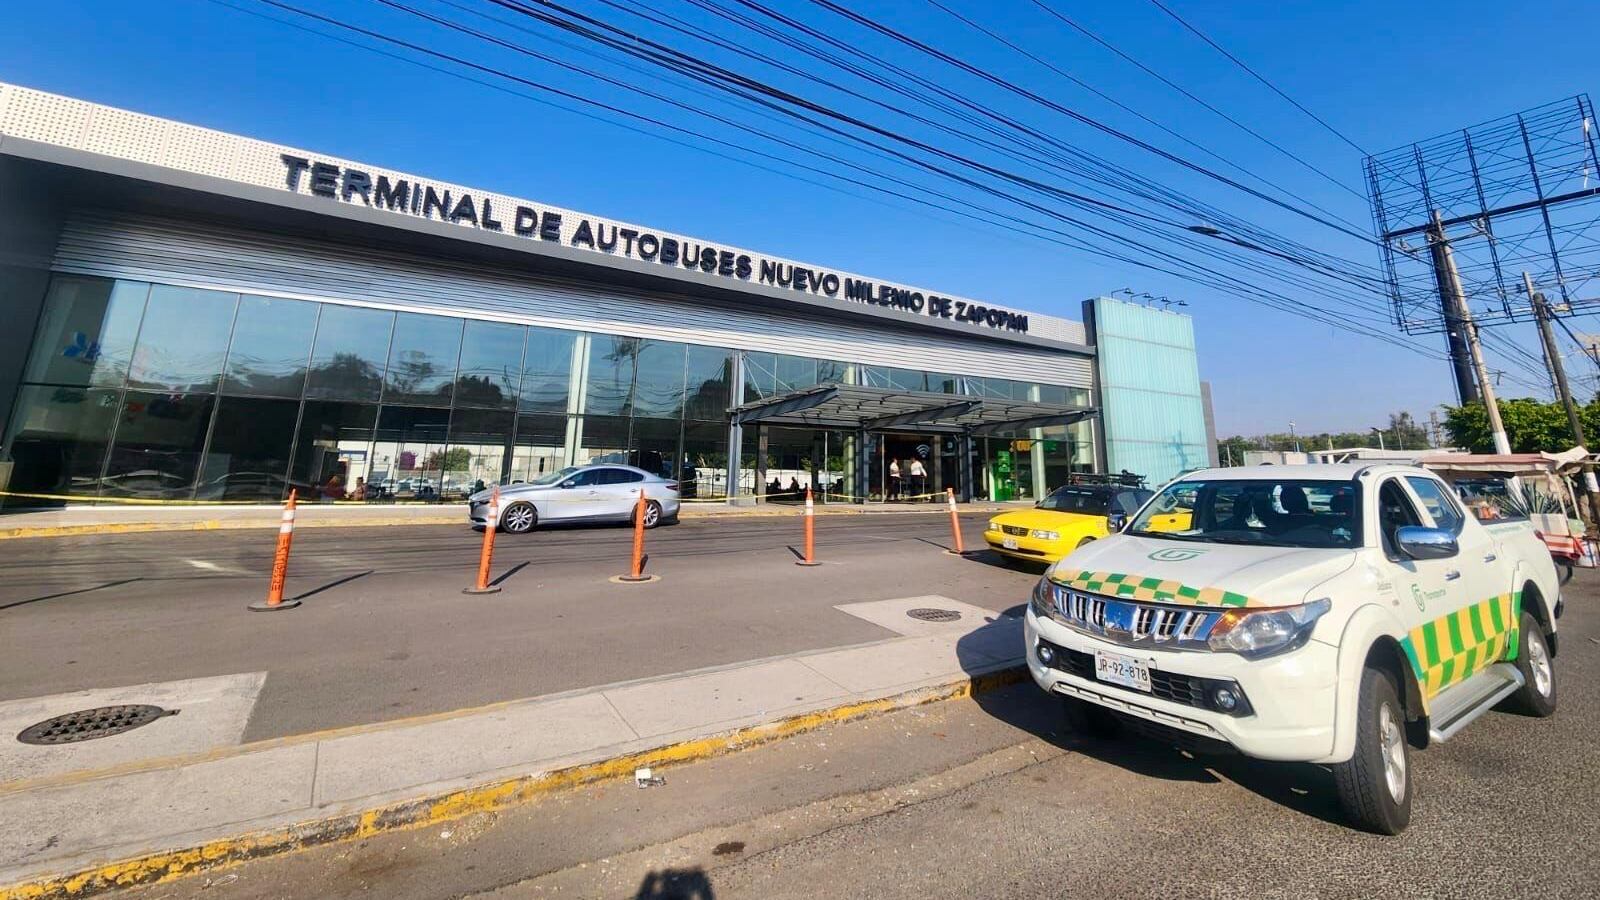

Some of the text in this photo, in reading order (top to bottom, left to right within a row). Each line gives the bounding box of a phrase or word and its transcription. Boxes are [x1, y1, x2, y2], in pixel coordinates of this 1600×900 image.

[280, 154, 1029, 333] TERMINAL DE AUTOBUSES NUEVO MILENIO DE ZAPOPAN
[1097, 657, 1148, 682] JR-92-878
